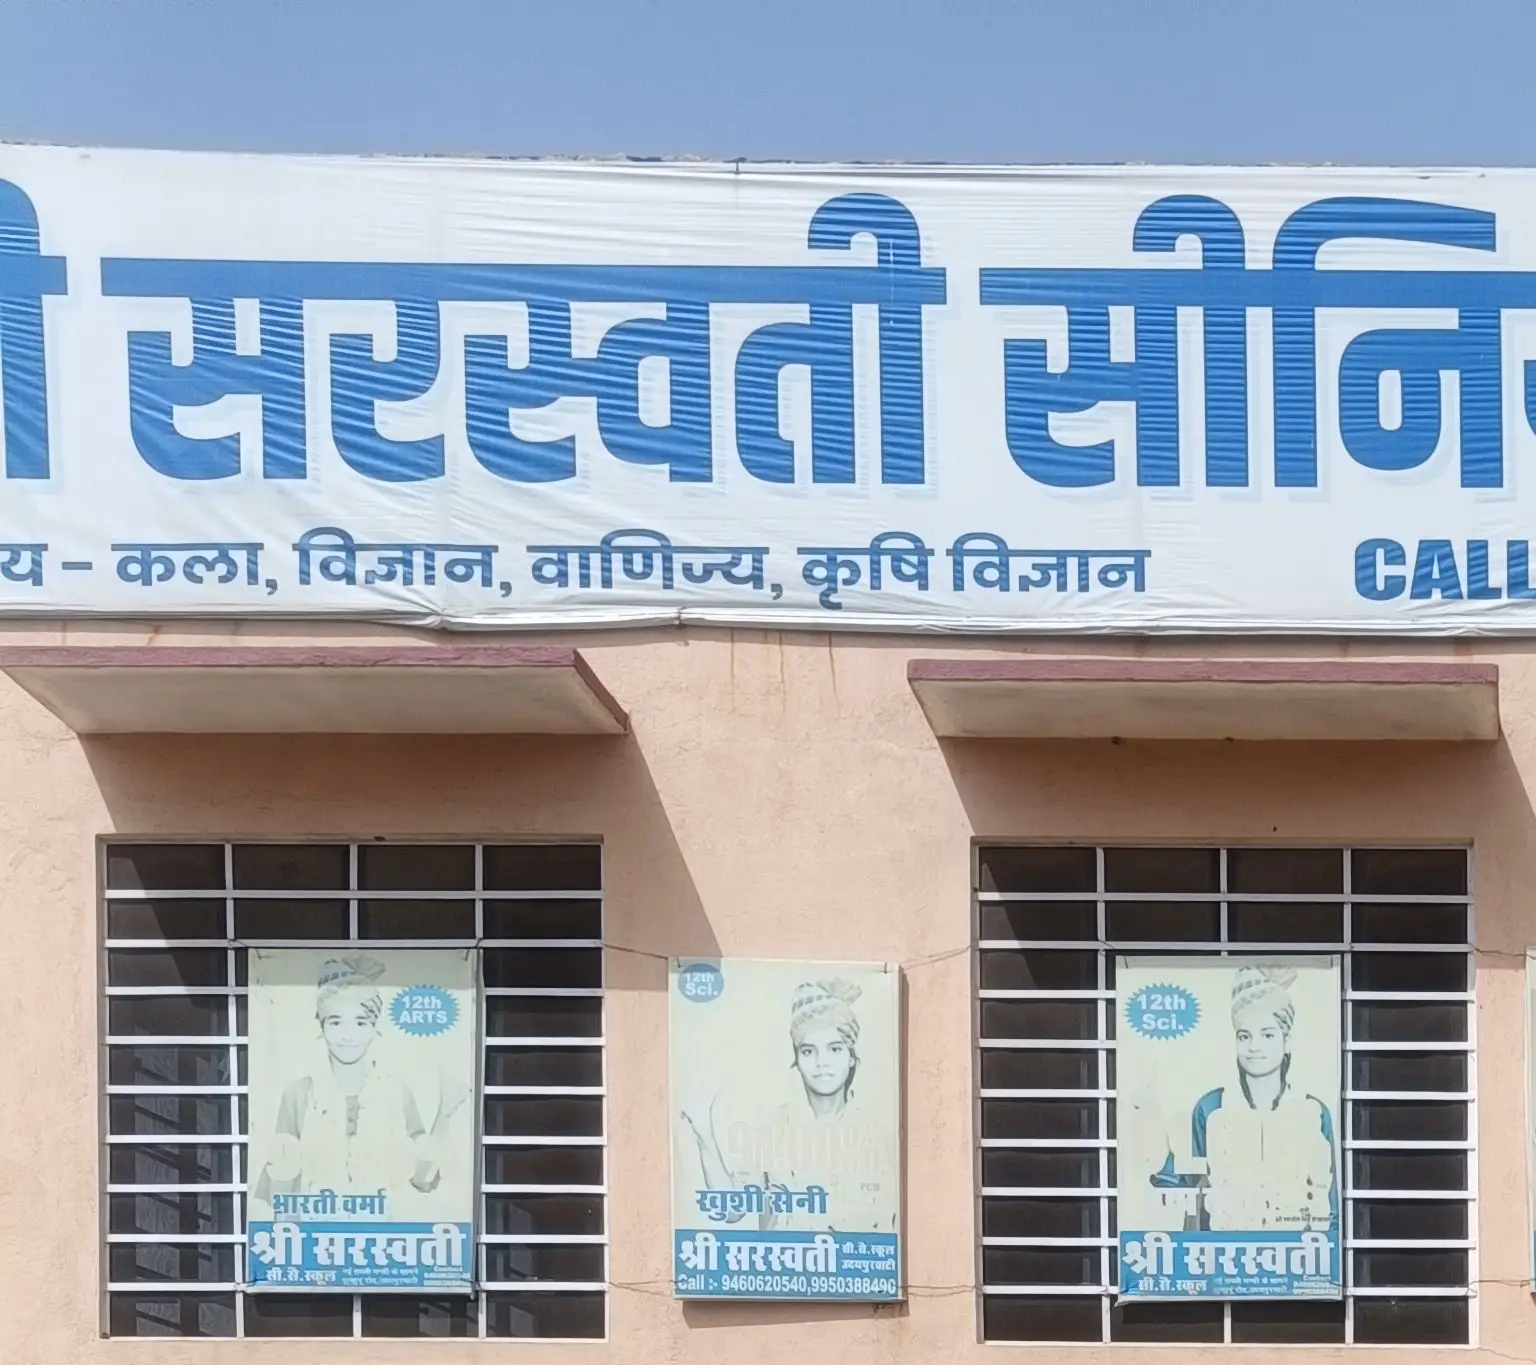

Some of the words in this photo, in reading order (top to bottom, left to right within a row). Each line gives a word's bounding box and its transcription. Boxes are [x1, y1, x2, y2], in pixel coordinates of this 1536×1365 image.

[101, 192, 946, 484] सरस्वती
[293, 527, 511, 597] विज्ञान,
[526, 528, 783, 600] वाणिज्य,
[797, 532, 934, 609] कृषि
[946, 532, 1151, 593] विज्ञान
[685, 971, 715, 983] 12th
[685, 982, 718, 996] Sci.
[402, 995, 442, 1009] 12th
[1137, 994, 1186, 1011] 12th
[399, 1010, 448, 1024] ARTS
[1142, 1013, 1184, 1030] Sci.
[273, 1188, 338, 1215] भारती
[342, 1188, 387, 1215] वर्मा
[695, 1184, 766, 1221] खुशी
[770, 1184, 829, 1214] सैनी
[250, 1222, 307, 1266] श्री
[312, 1223, 467, 1267] सरस्वती
[679, 1232, 720, 1272] श्री
[724, 1234, 840, 1273] सरस्वती
[1123, 1232, 1177, 1275] श्री
[1182, 1232, 1335, 1275] सरस्वती
[677, 1274, 705, 1291] Call
